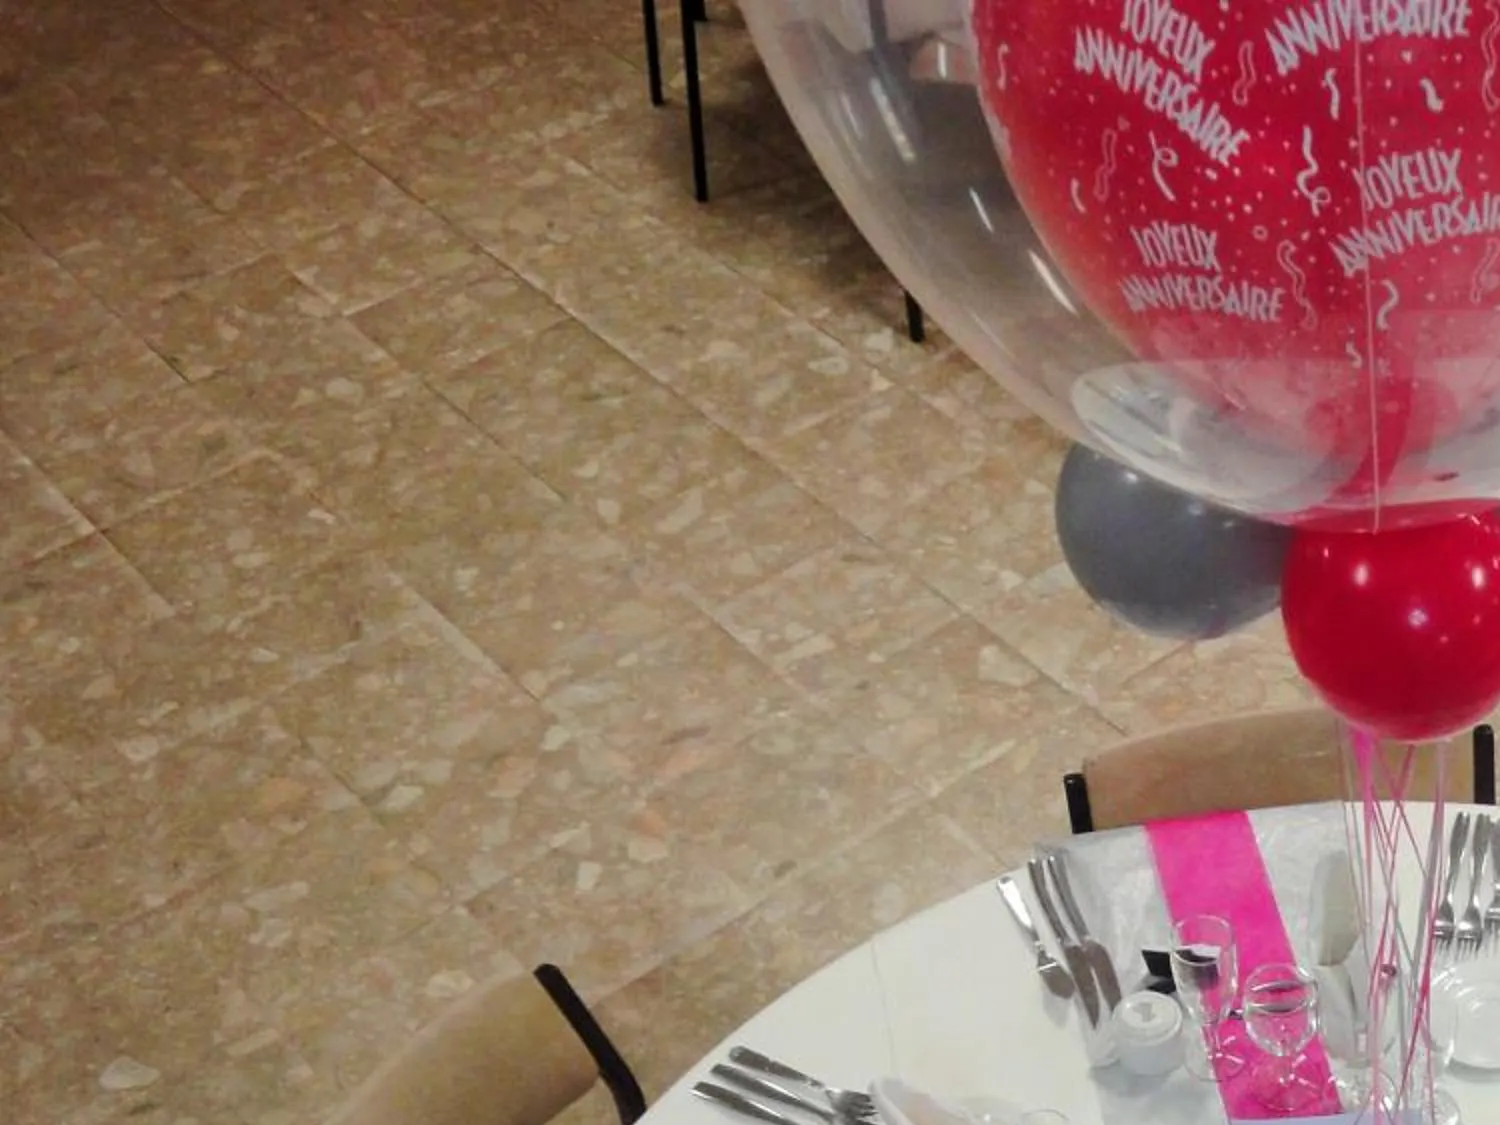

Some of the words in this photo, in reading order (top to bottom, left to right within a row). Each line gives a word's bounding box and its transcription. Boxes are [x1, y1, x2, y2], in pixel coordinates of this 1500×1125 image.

[1120, 0, 1216, 83] JOYEUX
[1264, 0, 1472, 76] ANNIVERSAIRE
[1074, 24, 1250, 167] ANNIVERSAIRE
[1352, 147, 1463, 211] JOYEUX
[1129, 220, 1221, 272] JOYEUX
[1117, 271, 1286, 322] ANNIVERSAIRE
